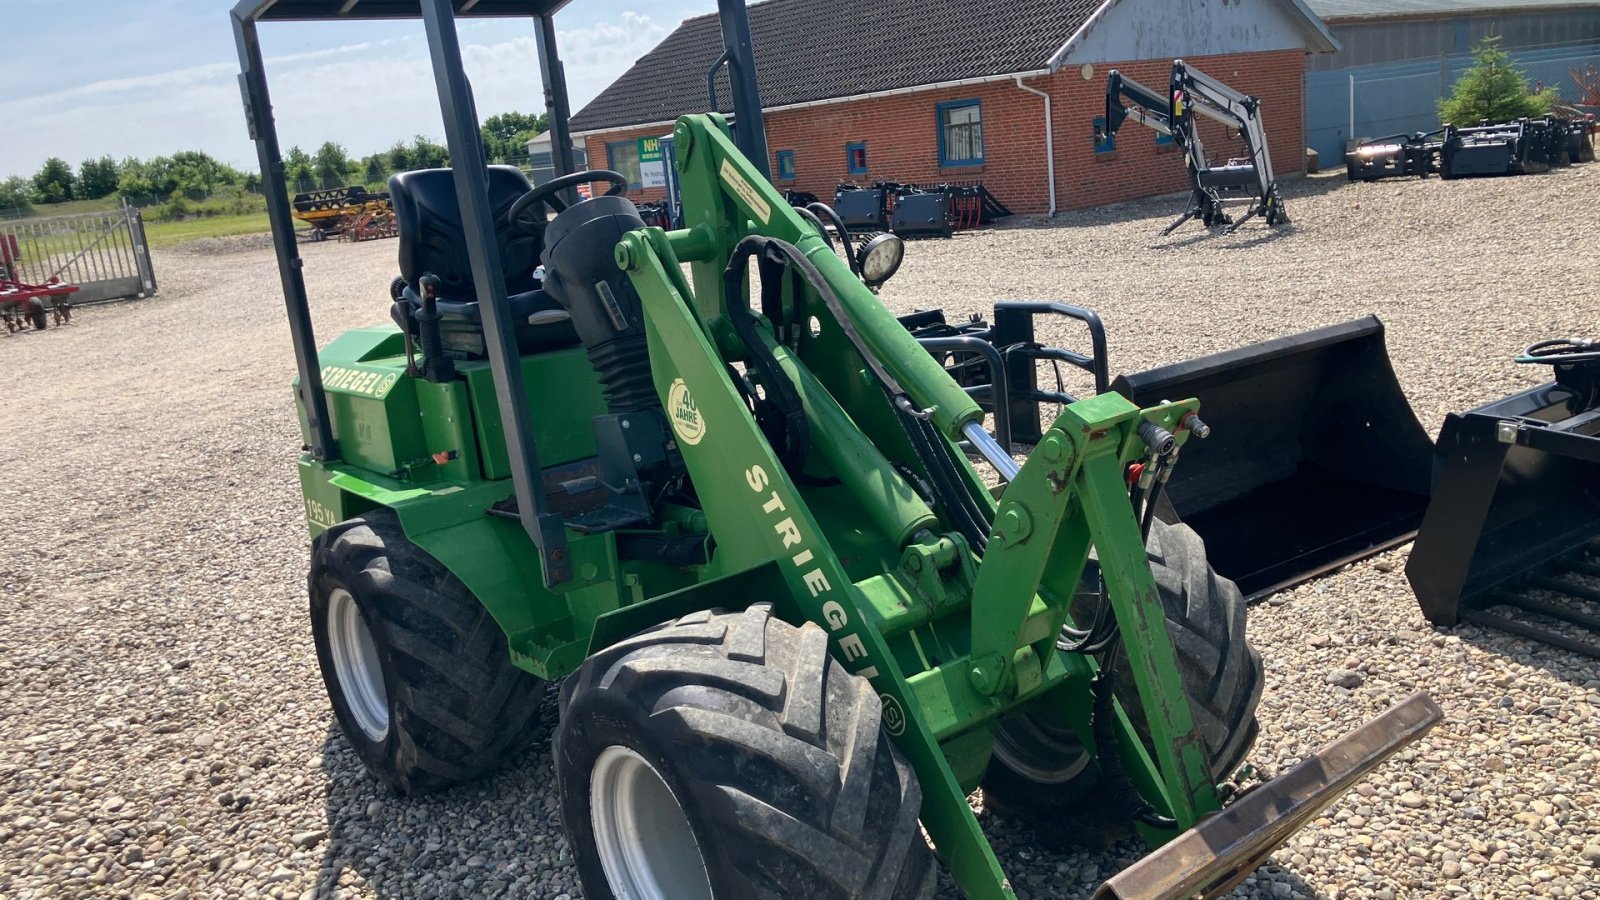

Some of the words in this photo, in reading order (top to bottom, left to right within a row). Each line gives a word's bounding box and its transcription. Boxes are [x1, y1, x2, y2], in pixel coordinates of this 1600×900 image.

[321, 366, 382, 394] STRIEGEL
[683, 390, 697, 412] 40
[676, 406, 698, 425] JAHRE
[307, 498, 324, 522] 195
